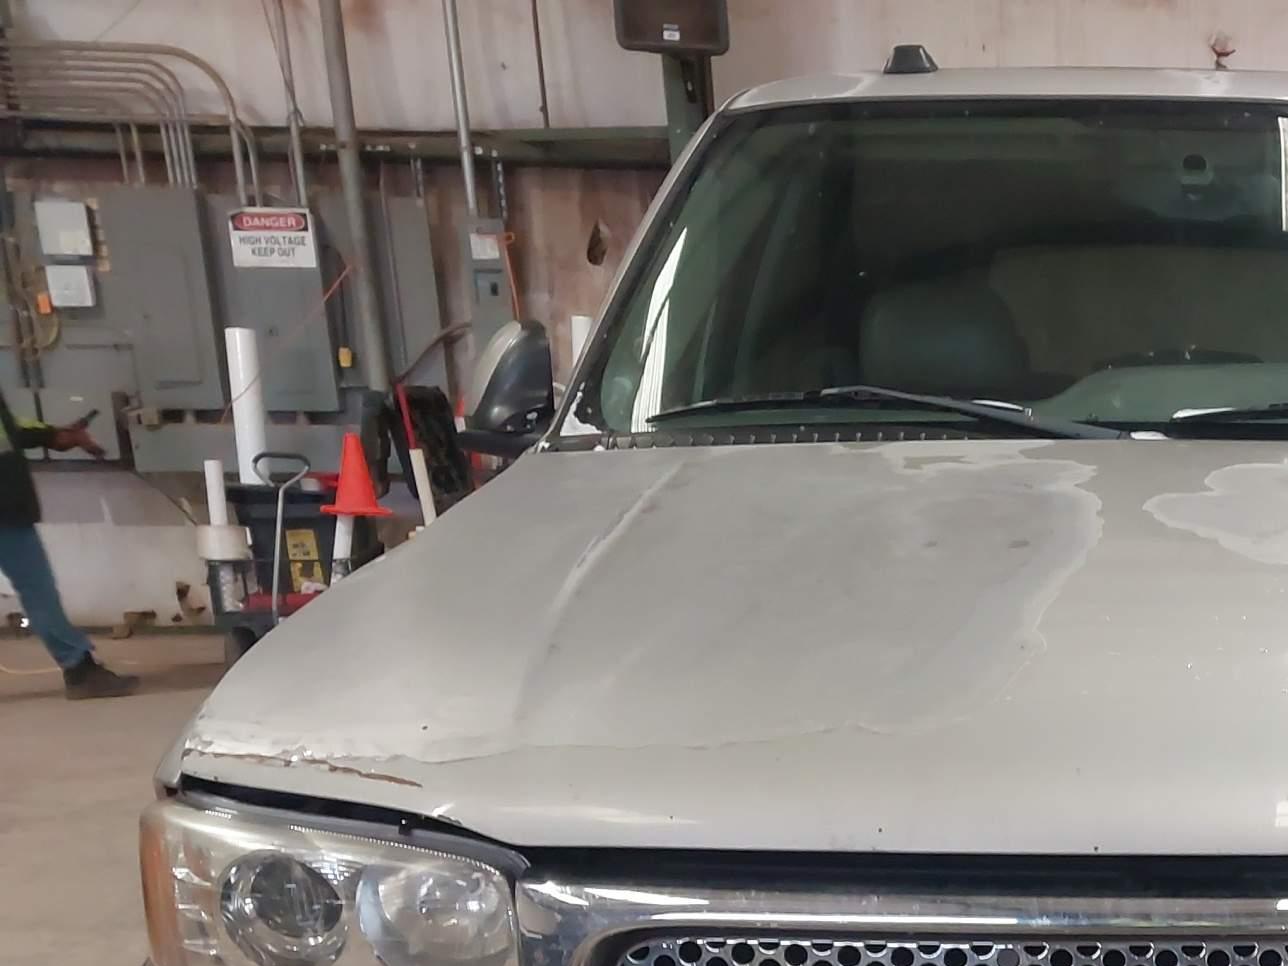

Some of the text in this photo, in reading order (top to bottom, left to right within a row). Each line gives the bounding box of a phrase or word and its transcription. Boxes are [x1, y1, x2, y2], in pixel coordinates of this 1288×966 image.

[242, 216, 296, 228] DANGER
[238, 236, 307, 247] HIGH VOLTAGE
[251, 247, 296, 257] KEEP OUT
